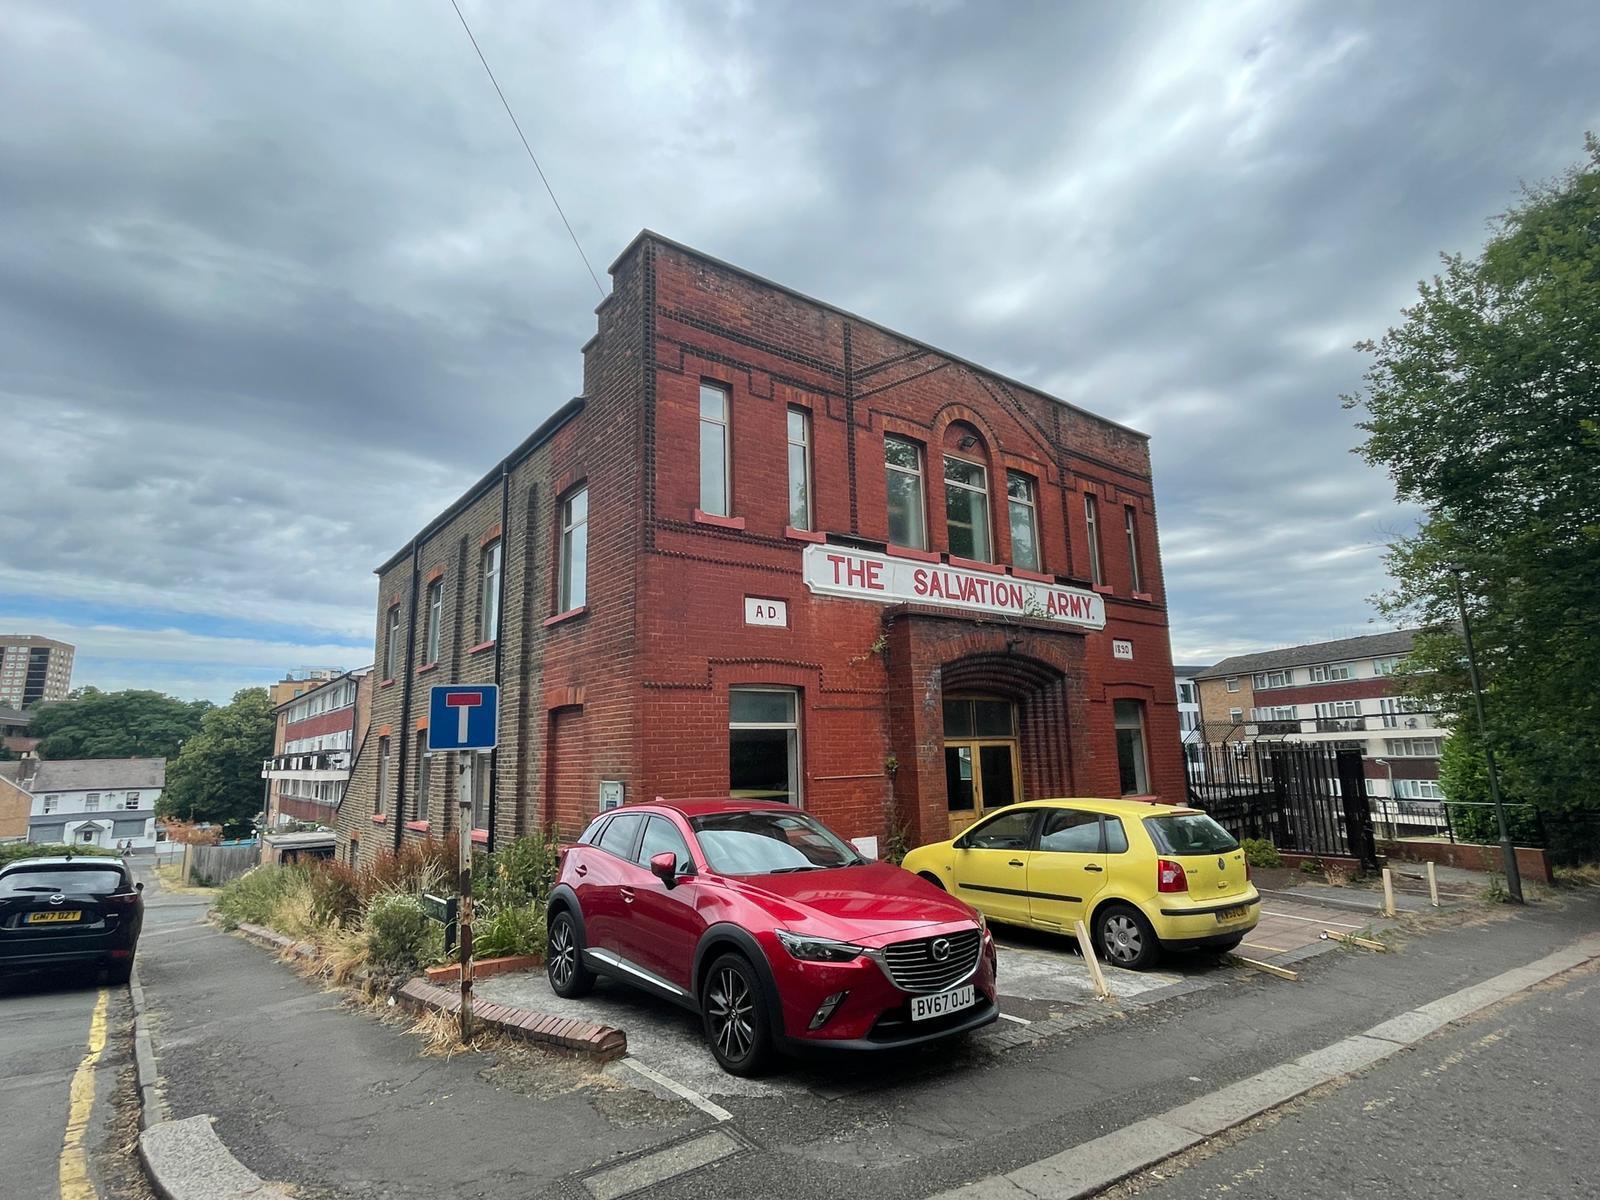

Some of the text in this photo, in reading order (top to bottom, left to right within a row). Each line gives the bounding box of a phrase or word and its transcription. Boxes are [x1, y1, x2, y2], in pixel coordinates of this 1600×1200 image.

[827, 554, 885, 590] THE
[913, 568, 1024, 608] SALVATION
[917, 987, 971, 1016] BV67 OJJ
